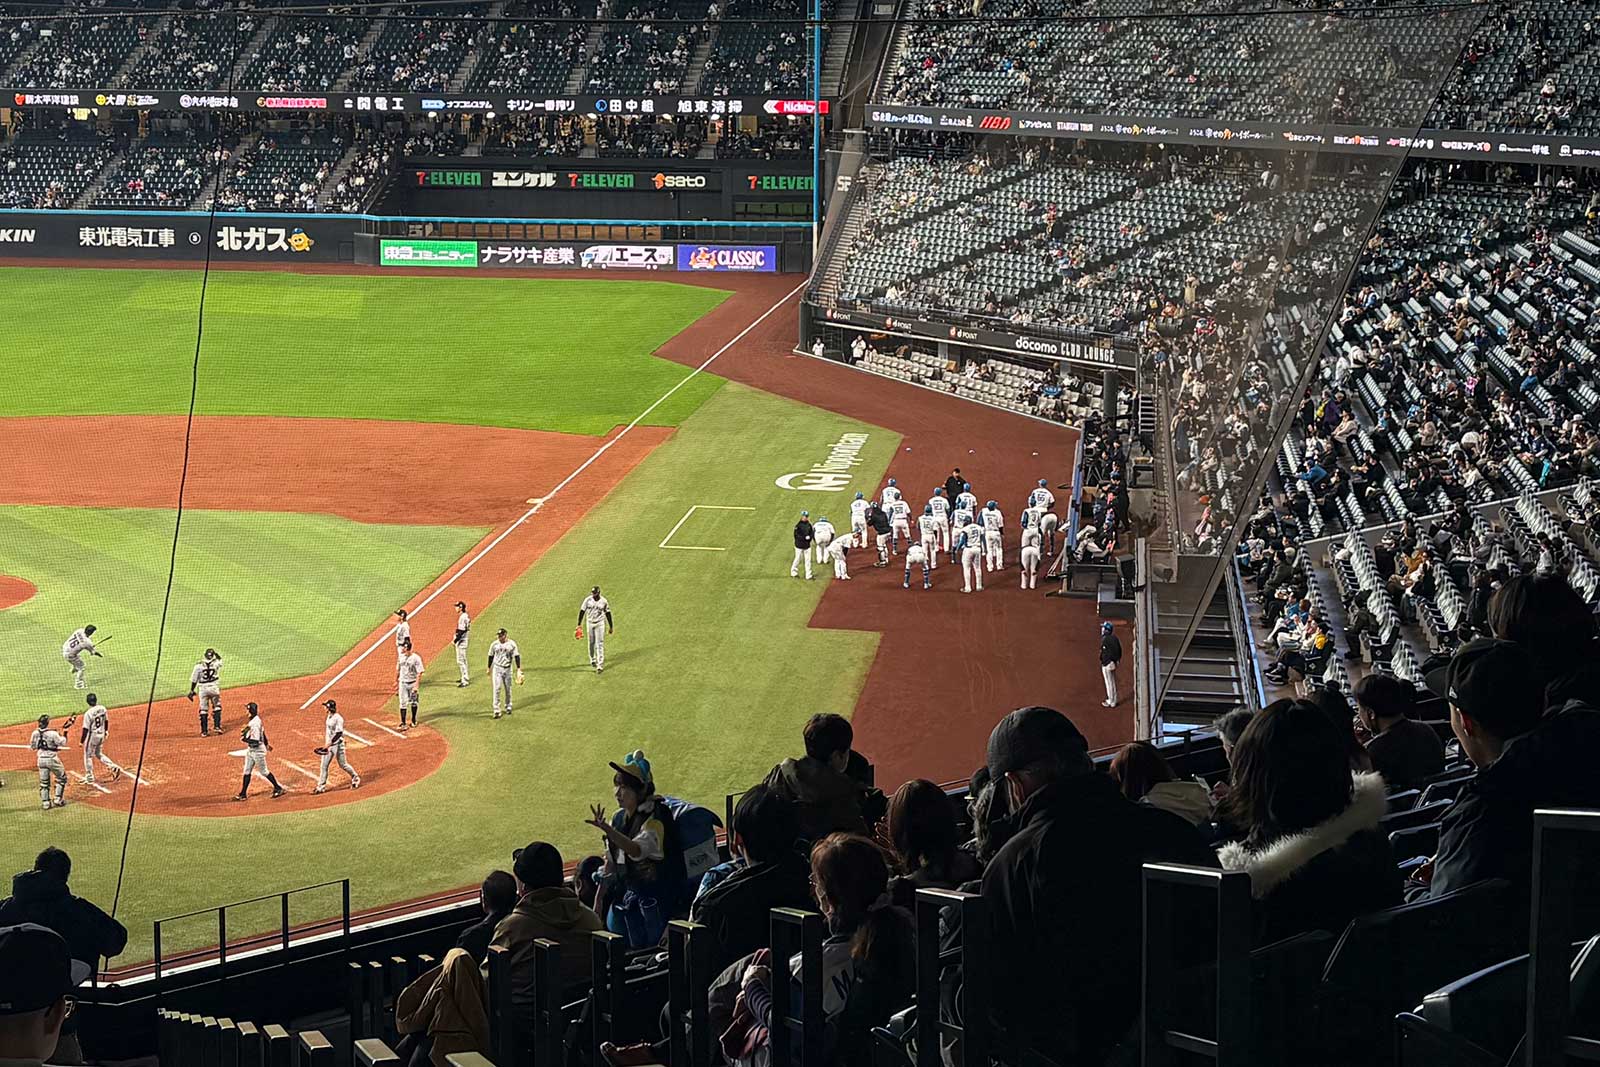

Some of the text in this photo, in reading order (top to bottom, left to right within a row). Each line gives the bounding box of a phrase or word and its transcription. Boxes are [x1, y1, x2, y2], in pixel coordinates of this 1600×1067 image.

[506, 99, 576, 112] キリン一番搾り
[609, 99, 655, 113] 田中組
[491, 171, 557, 188] ユンケル
[664, 174, 706, 188] sato
[79, 227, 176, 248] 東光電気工事
[216, 226, 289, 251] 北ガス
[481, 246, 575, 264] ナラサキ産業
[615, 248, 658, 263] エース
[717, 250, 765, 267] CLASSIC
[1015, 336, 1115, 364] docomo CLUB LOUNGE
[68, 633, 80, 650] 76
[203, 668, 215, 681] 32
